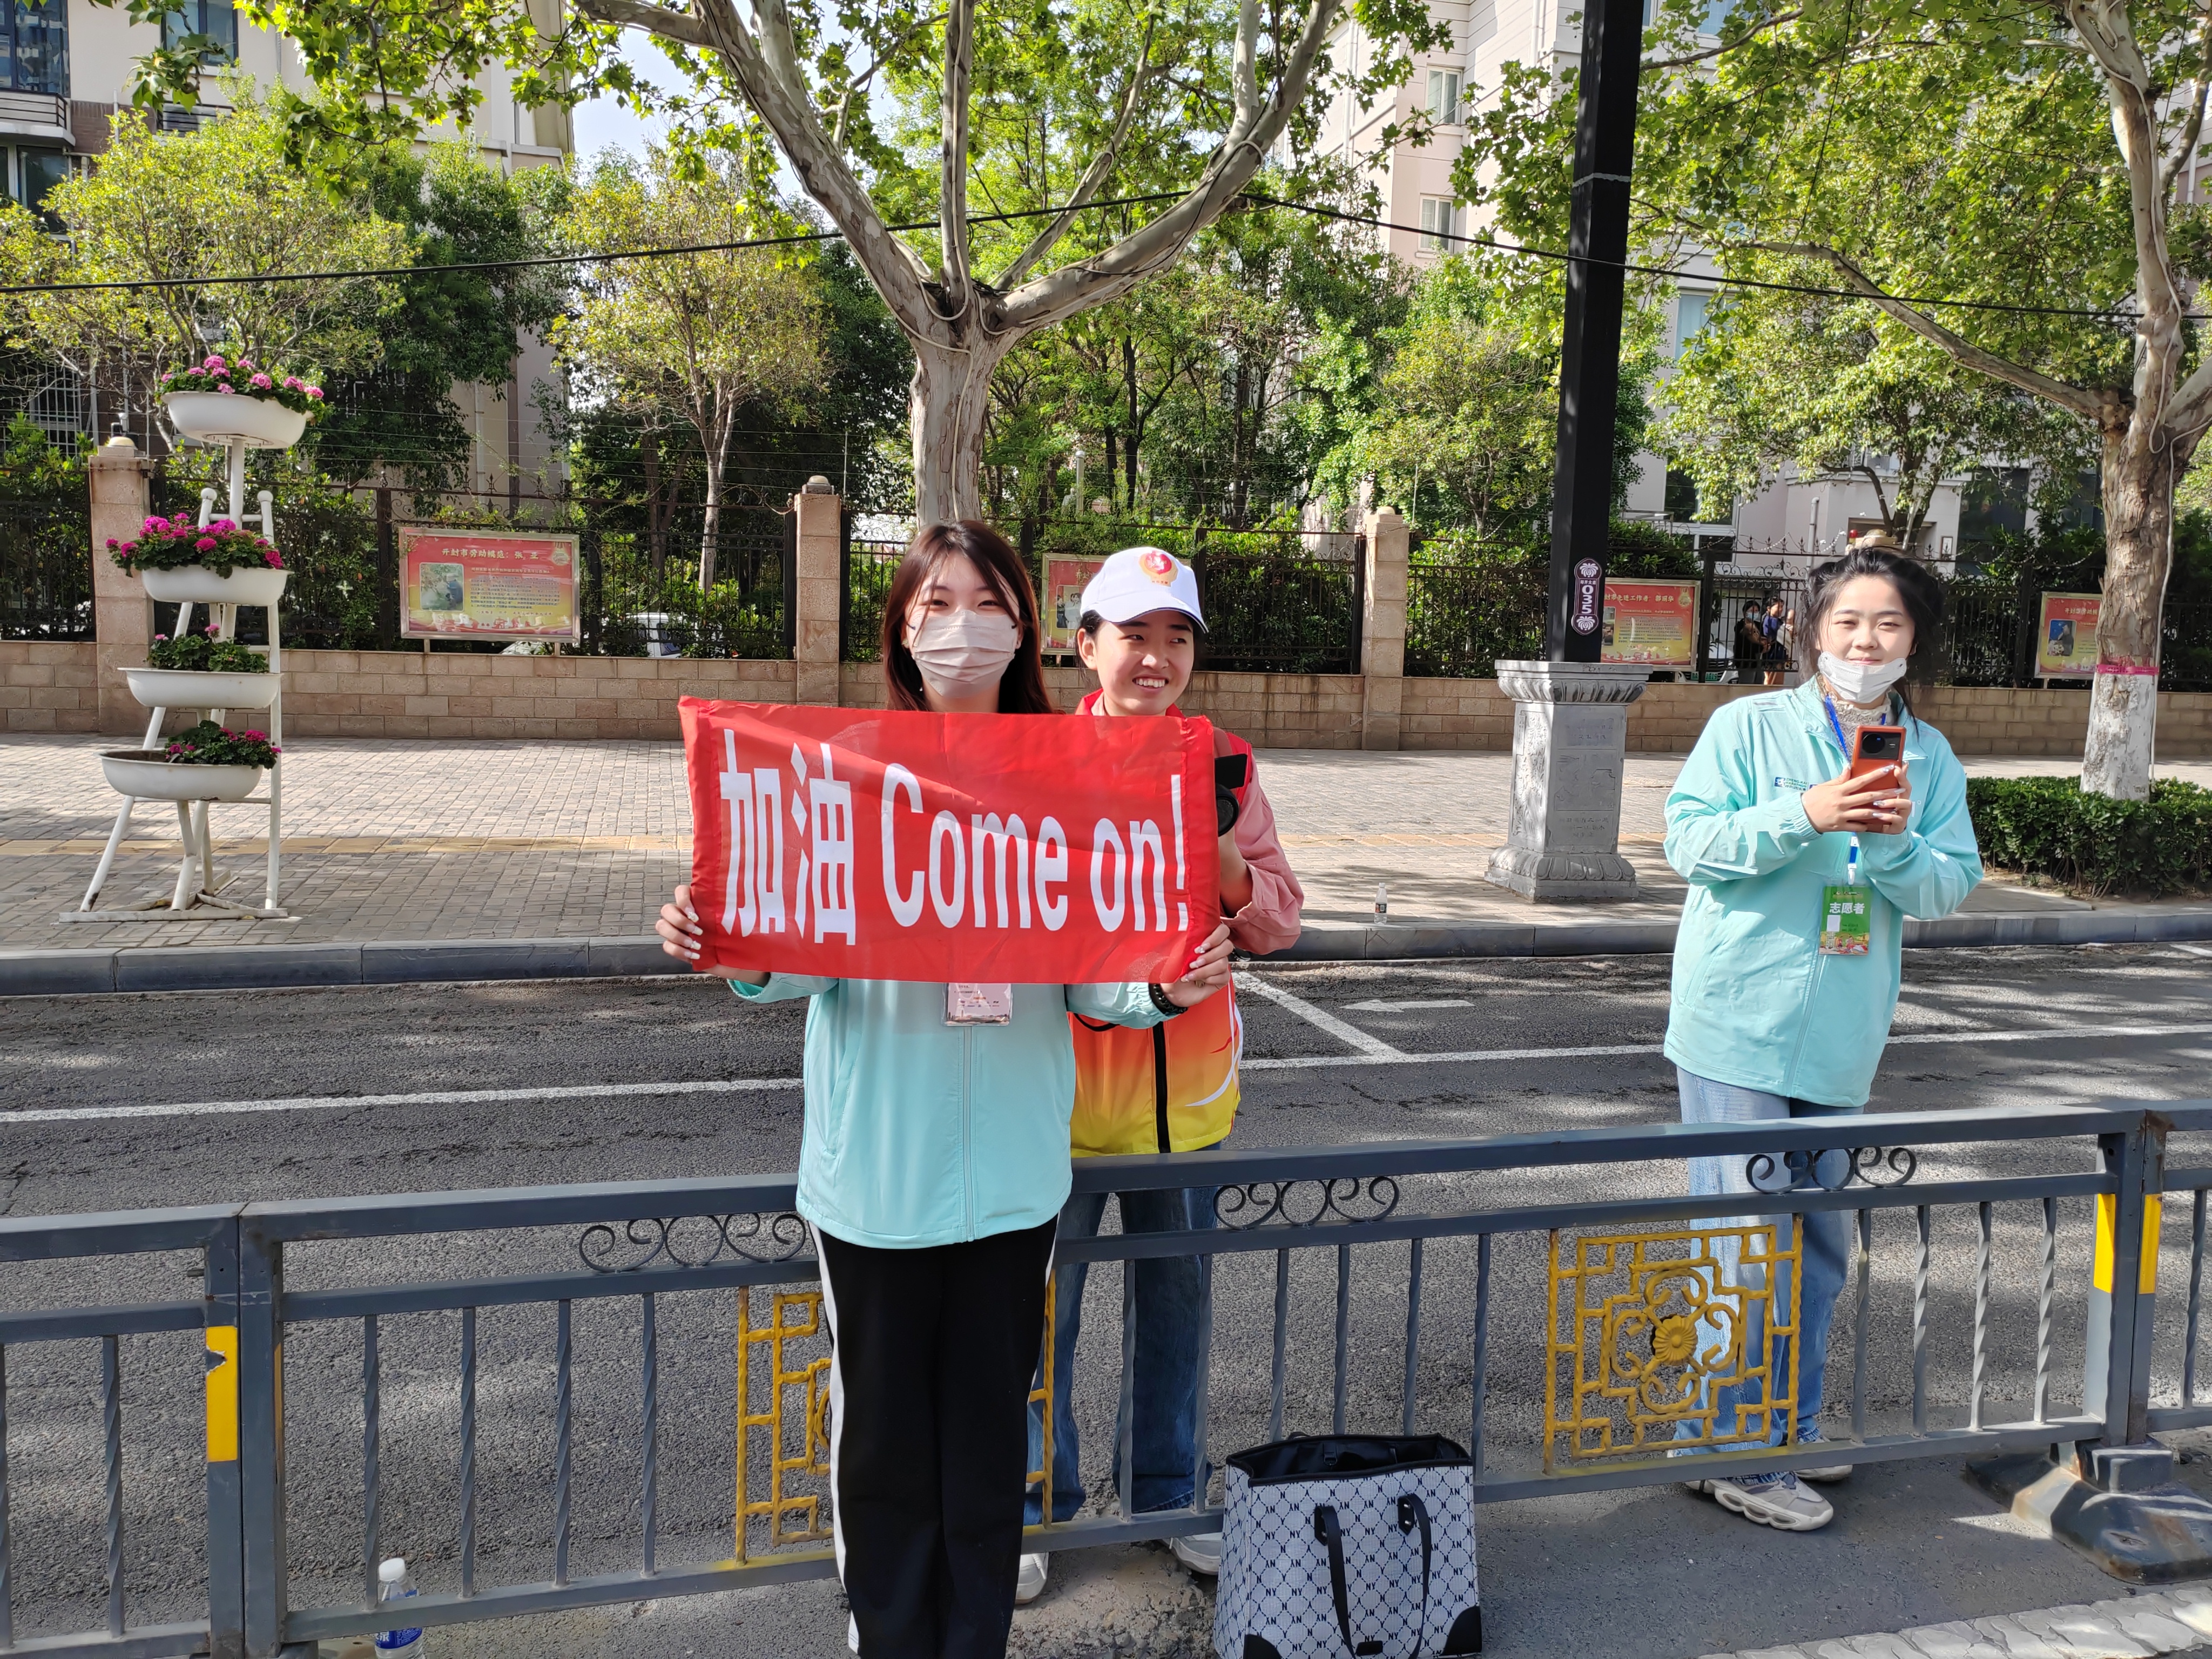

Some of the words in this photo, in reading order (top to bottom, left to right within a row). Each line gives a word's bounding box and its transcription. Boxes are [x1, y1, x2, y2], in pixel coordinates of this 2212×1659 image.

[1581, 585, 1594, 614] 035
[719, 729, 856, 946] 加油
[881, 763, 1068, 932] Come
[1089, 774, 1189, 932] on!
[1829, 902, 1865, 914] 志愿者
